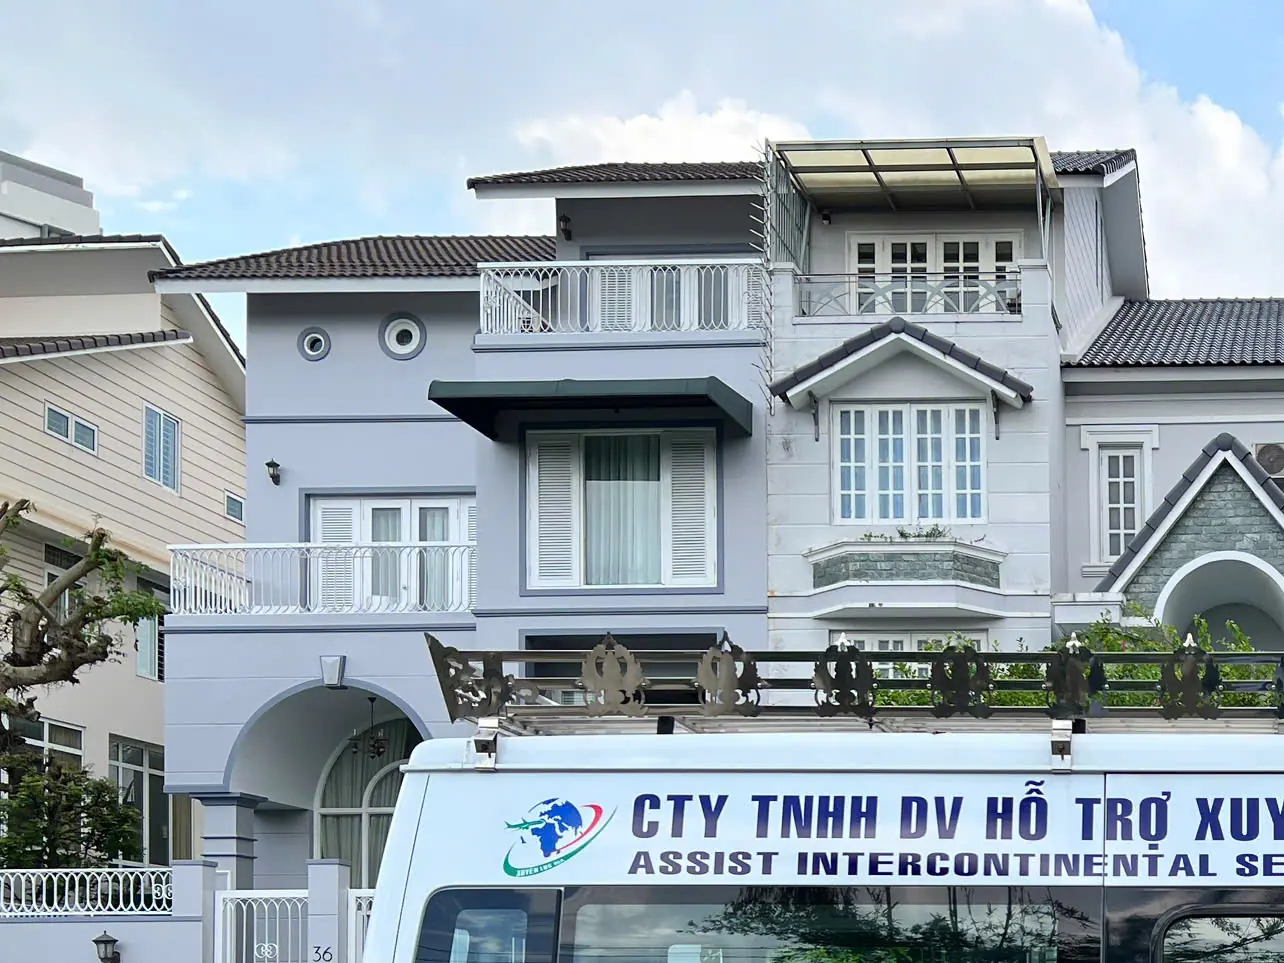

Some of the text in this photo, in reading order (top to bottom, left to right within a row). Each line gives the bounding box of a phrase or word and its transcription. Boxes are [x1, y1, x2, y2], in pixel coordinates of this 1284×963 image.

[631, 793, 730, 839] CTY
[751, 795, 879, 839] TNHH
[900, 796, 964, 840] DV
[985, 780, 1049, 841] HỖ
[1075, 790, 1172, 851] TRỢ
[627, 851, 780, 876] ASSIST
[796, 851, 1218, 877] INTERCONTINENTAL
[312, 945, 333, 962] 36
